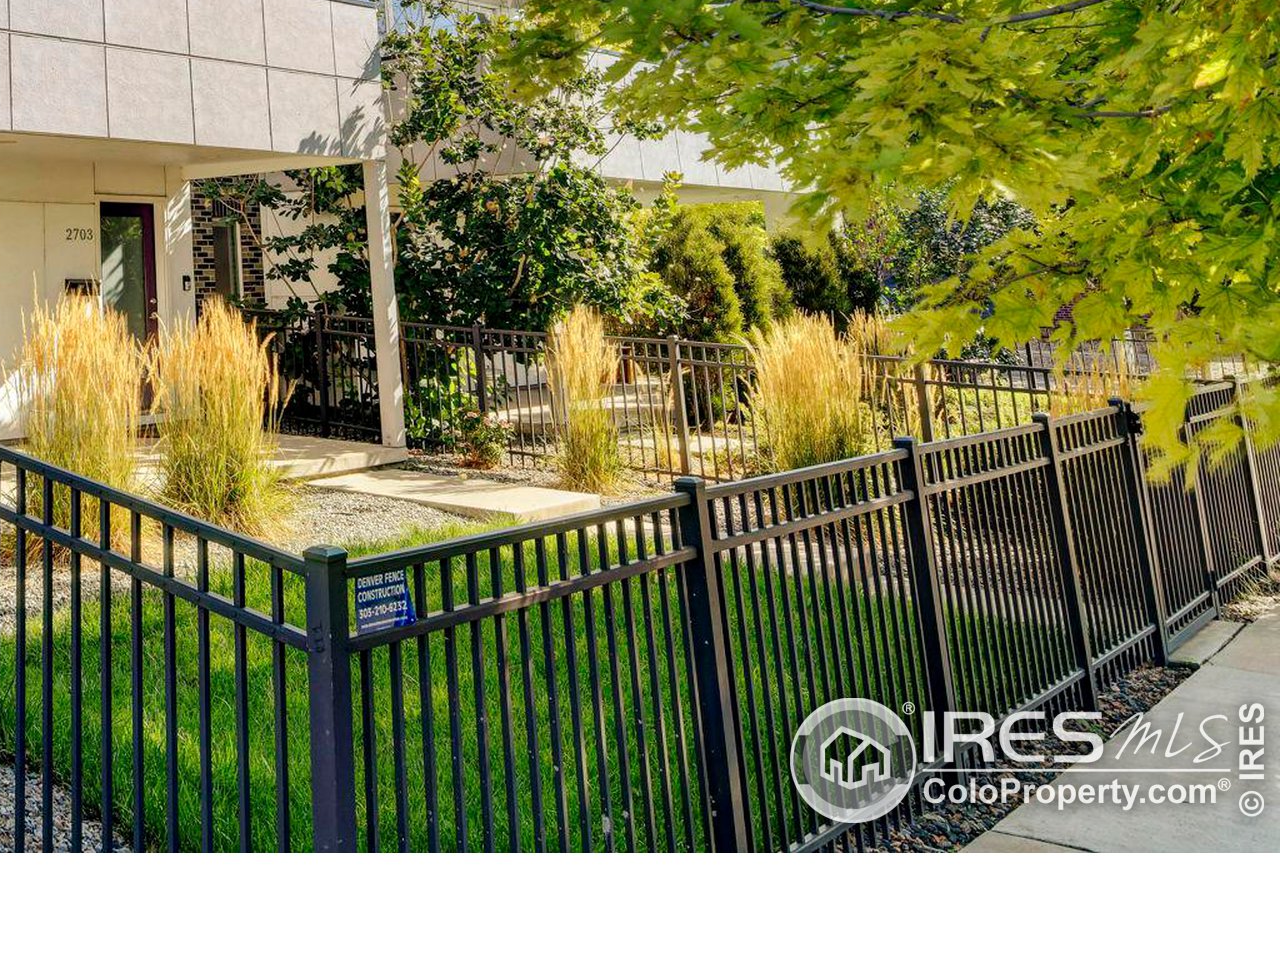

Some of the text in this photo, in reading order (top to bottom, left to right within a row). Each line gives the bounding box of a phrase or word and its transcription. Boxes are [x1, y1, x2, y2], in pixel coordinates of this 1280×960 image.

[66, 228, 93, 240] 2703
[357, 570, 404, 589] DENVER FENCE
[357, 584, 405, 603] CONSTRUCTION
